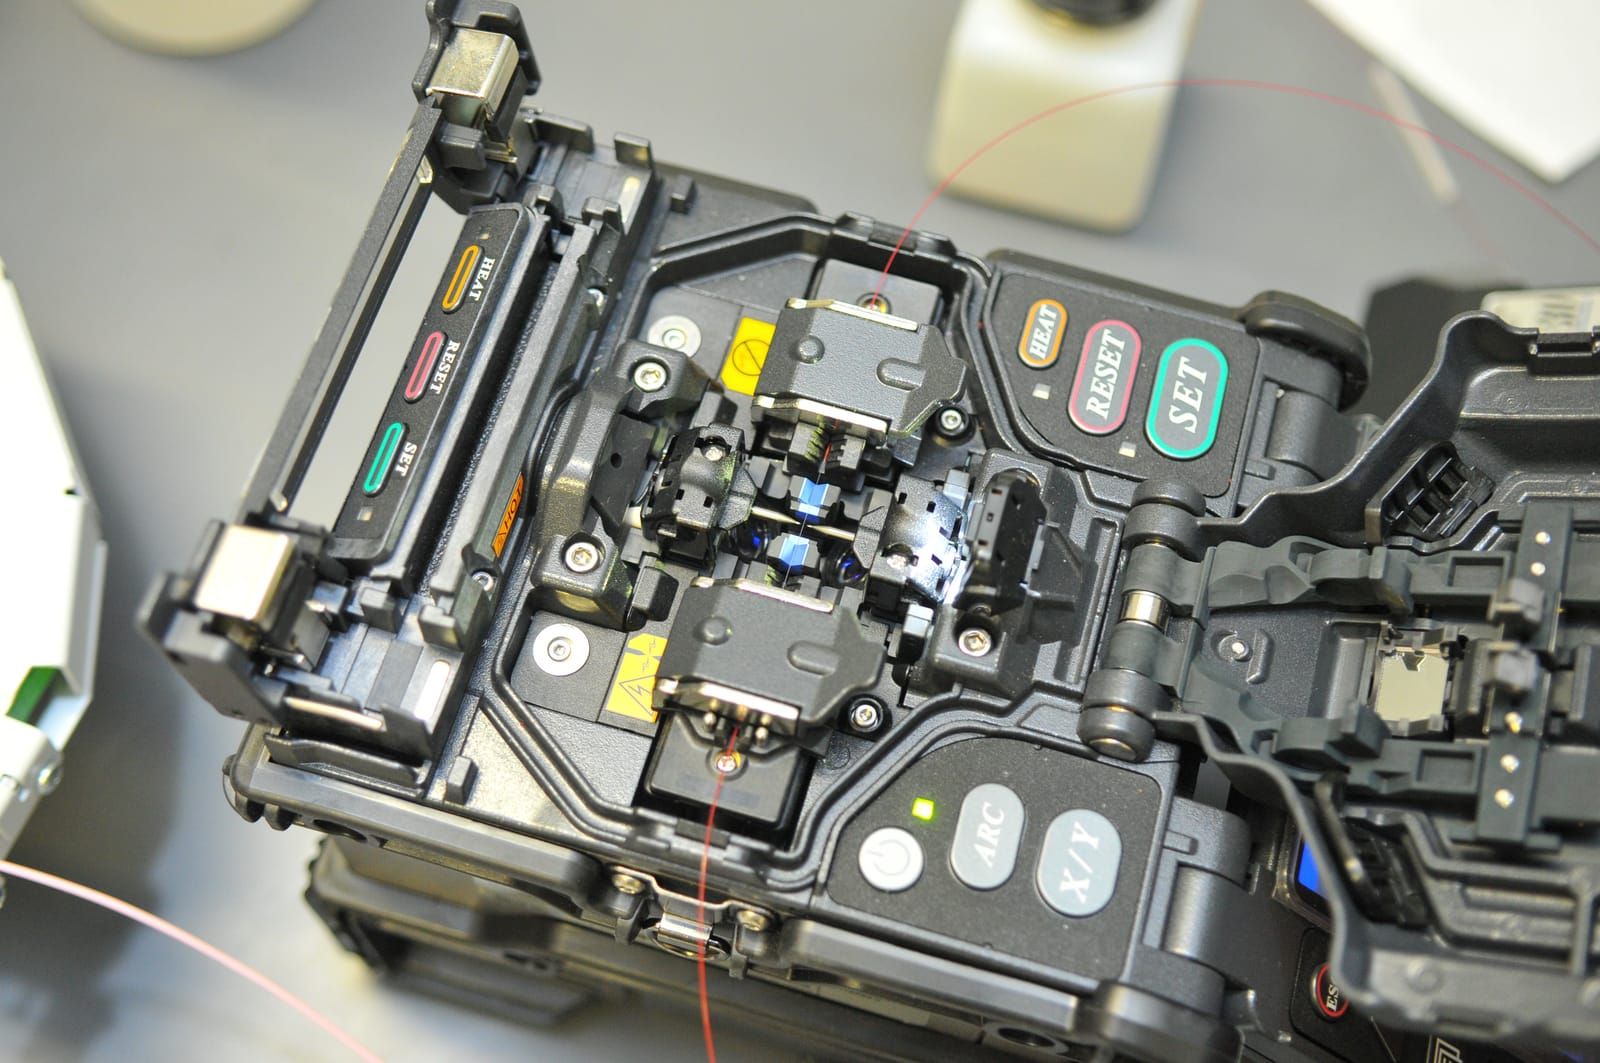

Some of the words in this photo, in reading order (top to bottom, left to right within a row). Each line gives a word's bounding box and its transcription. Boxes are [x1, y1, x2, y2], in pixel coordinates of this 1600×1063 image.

[469, 257, 496, 302] HEAT
[1029, 303, 1058, 360] HEAT
[430, 339, 461, 395] RESET
[1085, 328, 1126, 421] RESET
[1168, 356, 1208, 434] SET
[395, 441, 417, 477] SET
[504, 482, 521, 530] HOT
[973, 801, 1006, 868] ARC
[1058, 820, 1100, 905] X/Y
[1326, 983, 1340, 1012] ES
